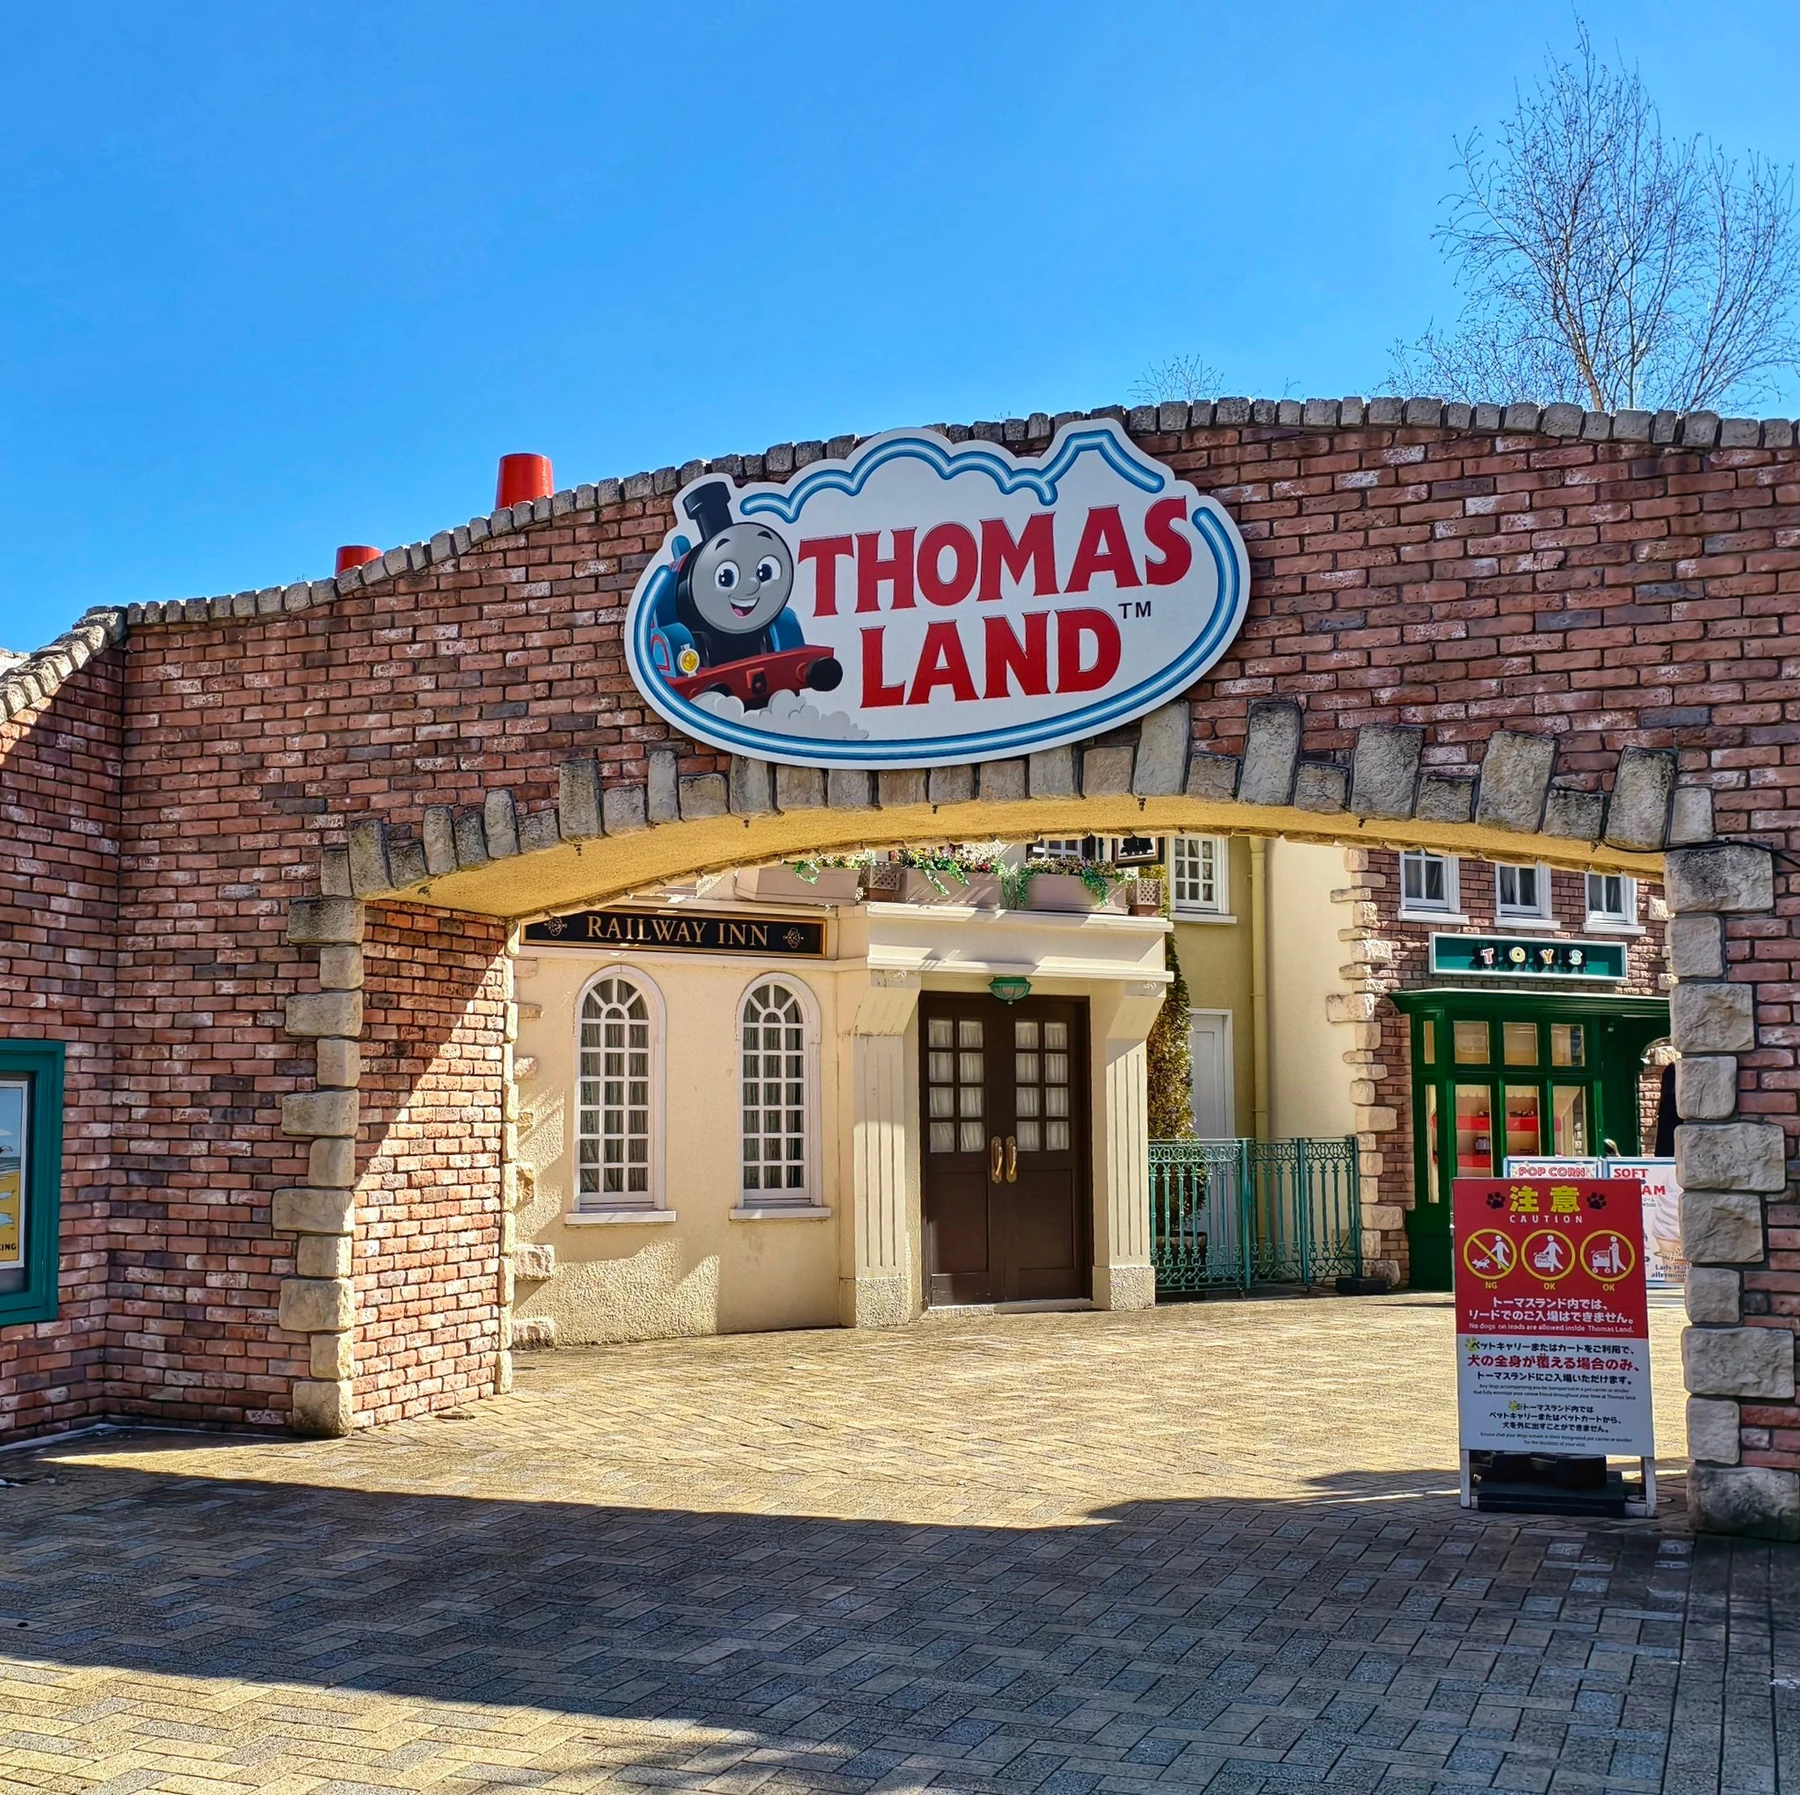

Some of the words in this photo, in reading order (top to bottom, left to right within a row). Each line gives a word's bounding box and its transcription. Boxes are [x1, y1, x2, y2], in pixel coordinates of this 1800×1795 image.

[799, 496, 1193, 617] THOMAS
[859, 606, 1122, 709] LAND
[1119, 601, 1152, 620] TM
[587, 915, 707, 943] RAILWAY
[717, 922, 769, 946] INN
[1480, 946, 1583, 966] TOYS
[1518, 1166, 1546, 1177] POP
[1548, 1166, 1586, 1178] CORN
[1613, 1168, 1649, 1179] SOFT
[1641, 1185, 1666, 1195] AM
[1509, 1185, 1581, 1213] 注意
[1509, 1214, 1584, 1224] CAUTION
[1484, 1281, 1498, 1290] NG
[1543, 1282, 1556, 1291] OK
[1602, 1283, 1616, 1292] OK
[1492, 1296, 1608, 1310] トーマスランド内では、
[1469, 1309, 1634, 1324] リードでのご入場はできません。
[1479, 1322, 1496, 1331] dogs
[1507, 1323, 1526, 1331] leads
[1538, 1323, 1564, 1331] allowed
[1565, 1324, 1586, 1332] inside
[1588, 1325, 1615, 1333] Thomas
